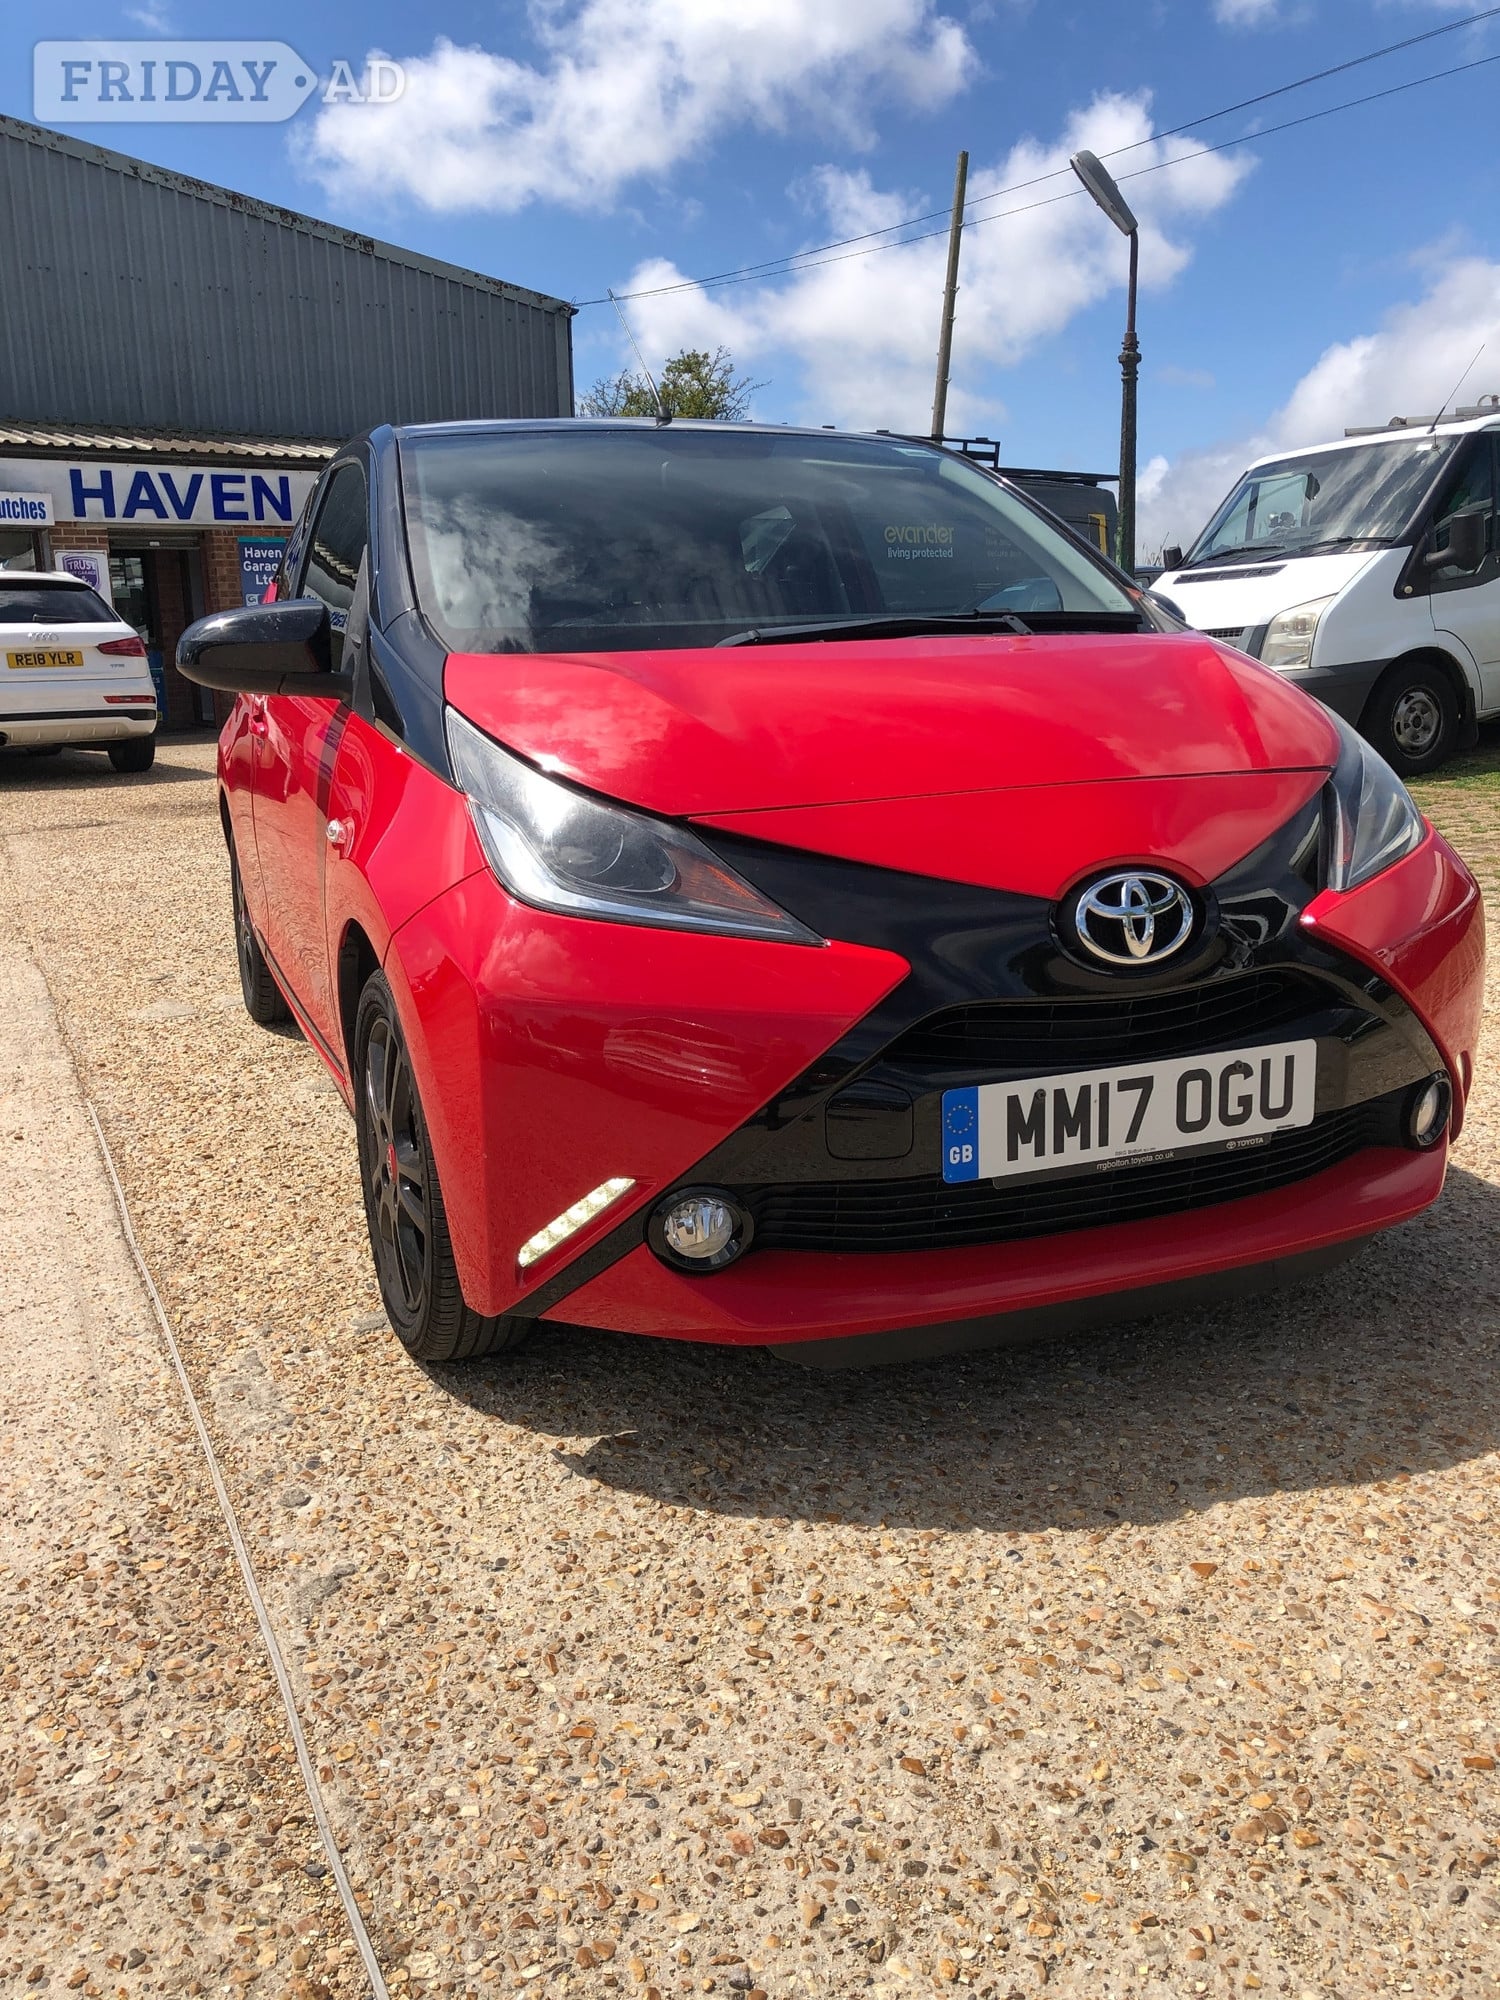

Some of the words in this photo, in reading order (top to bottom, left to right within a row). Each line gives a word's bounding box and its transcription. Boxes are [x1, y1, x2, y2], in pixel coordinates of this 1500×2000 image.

[69, 468, 293, 521] HAVEN
[884, 523, 955, 544] evander
[244, 547, 283, 558] Haven
[887, 547, 911, 560] living
[912, 547, 954, 560] protected
[67, 560, 96, 570] TRUST
[15, 652, 46, 666] RE18
[50, 651, 75, 665] YLR
[1006, 1075, 1154, 1162] MM17
[1175, 1055, 1295, 1134] OGU
[1236, 1137, 1264, 1148] TOYOTA
[949, 1143, 973, 1165] GB
